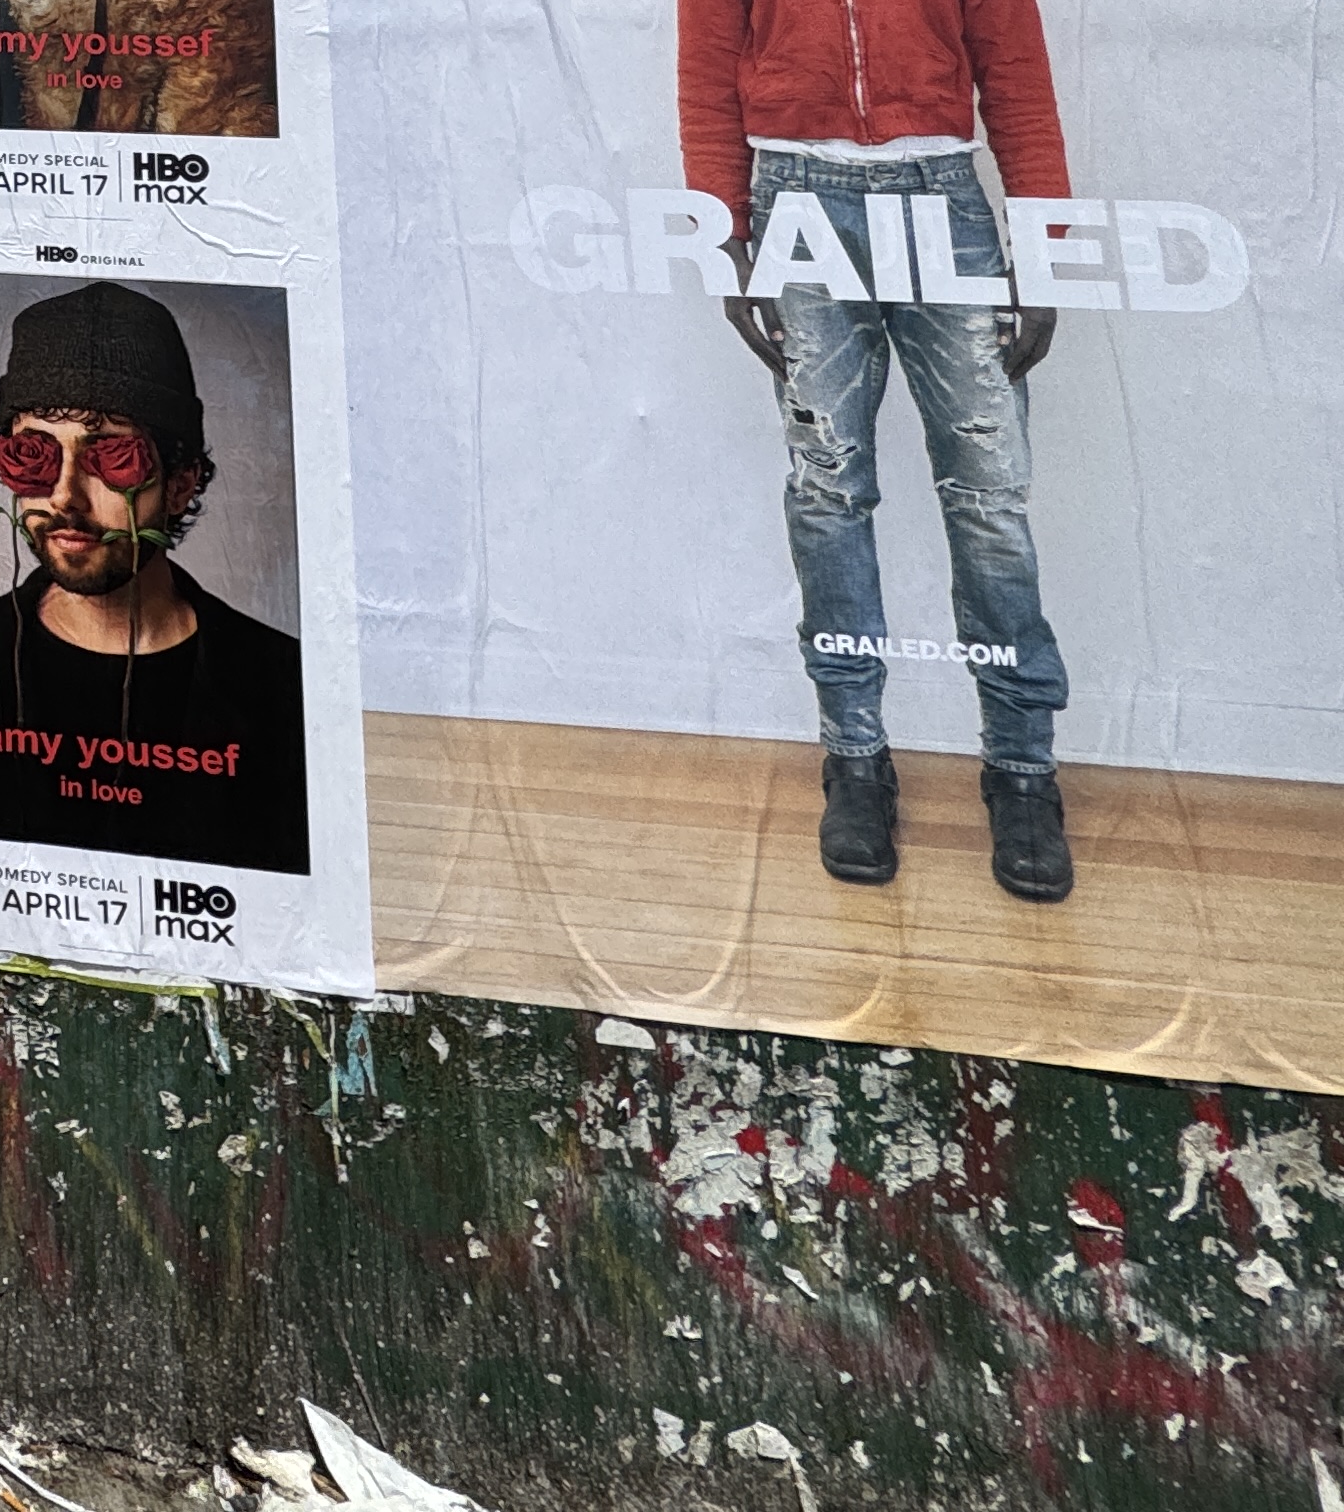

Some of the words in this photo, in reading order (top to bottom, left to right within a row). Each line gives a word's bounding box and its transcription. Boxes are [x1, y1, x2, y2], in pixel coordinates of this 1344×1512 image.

[62, 29, 214, 62] youssef
[47, 71, 66, 87] in
[76, 71, 122, 89] love
[44, 154, 109, 168] SPECIAL
[134, 152, 209, 182] HBO
[81, 175, 108, 196] 17
[134, 184, 208, 205] max
[36, 246, 78, 263] HBO
[80, 255, 145, 266] ORIGINAL
[510, 184, 1250, 312] GRAILED
[813, 632, 1017, 667] GRAILED.COM
[77, 735, 240, 777] youssef
[60, 775, 82, 798] in
[92, 779, 143, 805] love
[57, 872, 128, 894] SPECIAL
[2, 889, 89, 922] APRIL
[98, 899, 128, 926] 17
[154, 878, 236, 919] HBO
[154, 914, 236, 947] max
